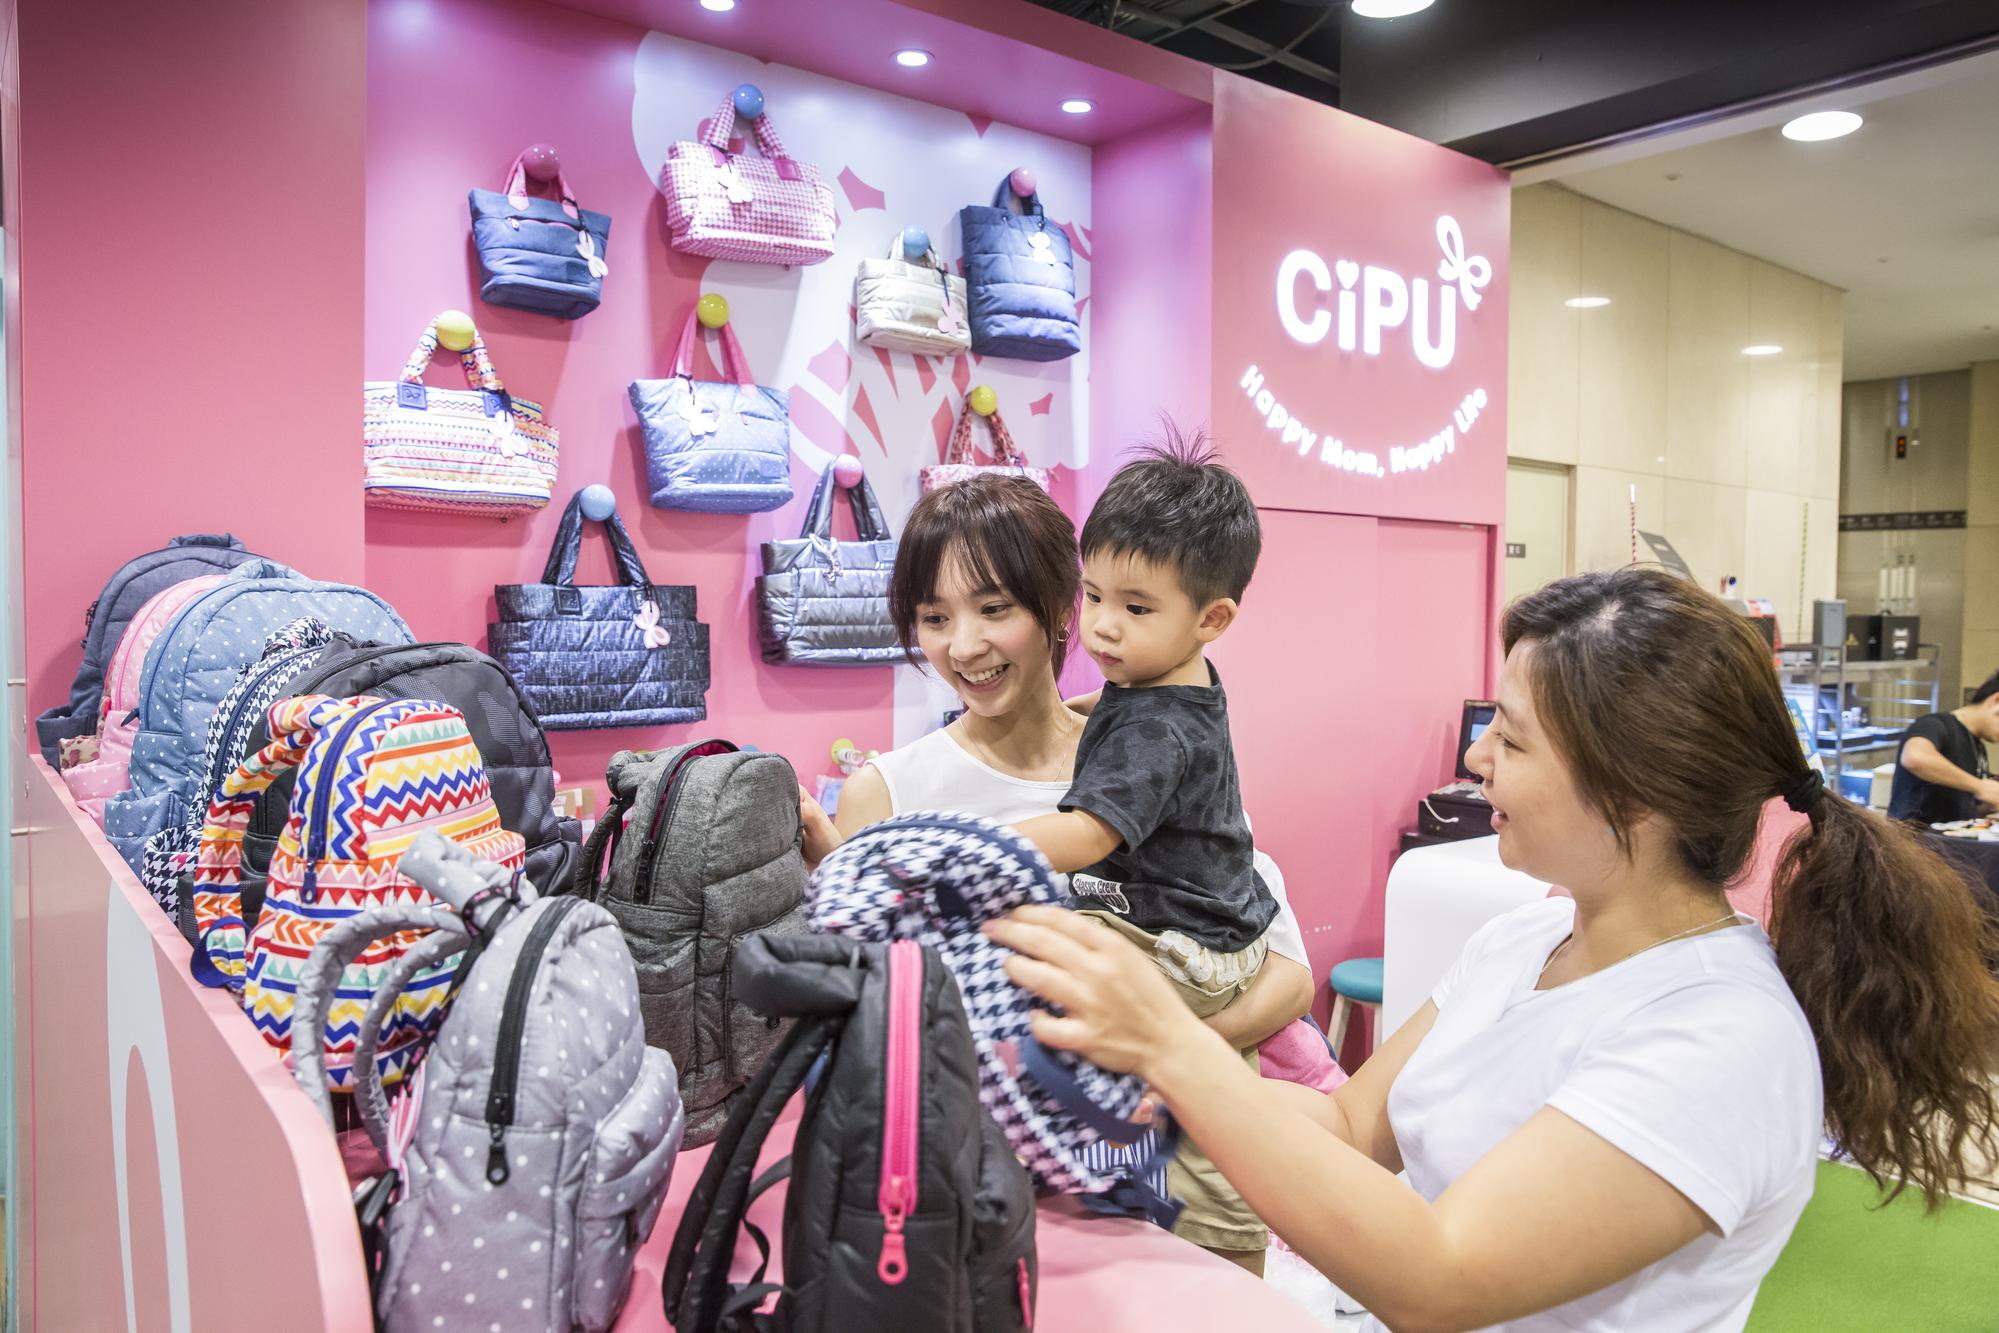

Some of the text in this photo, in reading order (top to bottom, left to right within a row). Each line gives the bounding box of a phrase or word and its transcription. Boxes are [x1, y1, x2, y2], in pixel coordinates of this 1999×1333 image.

[1240, 364, 1318, 456] Happy
[1320, 435, 1385, 478] Mom,
[1390, 425, 1455, 474] Happy
